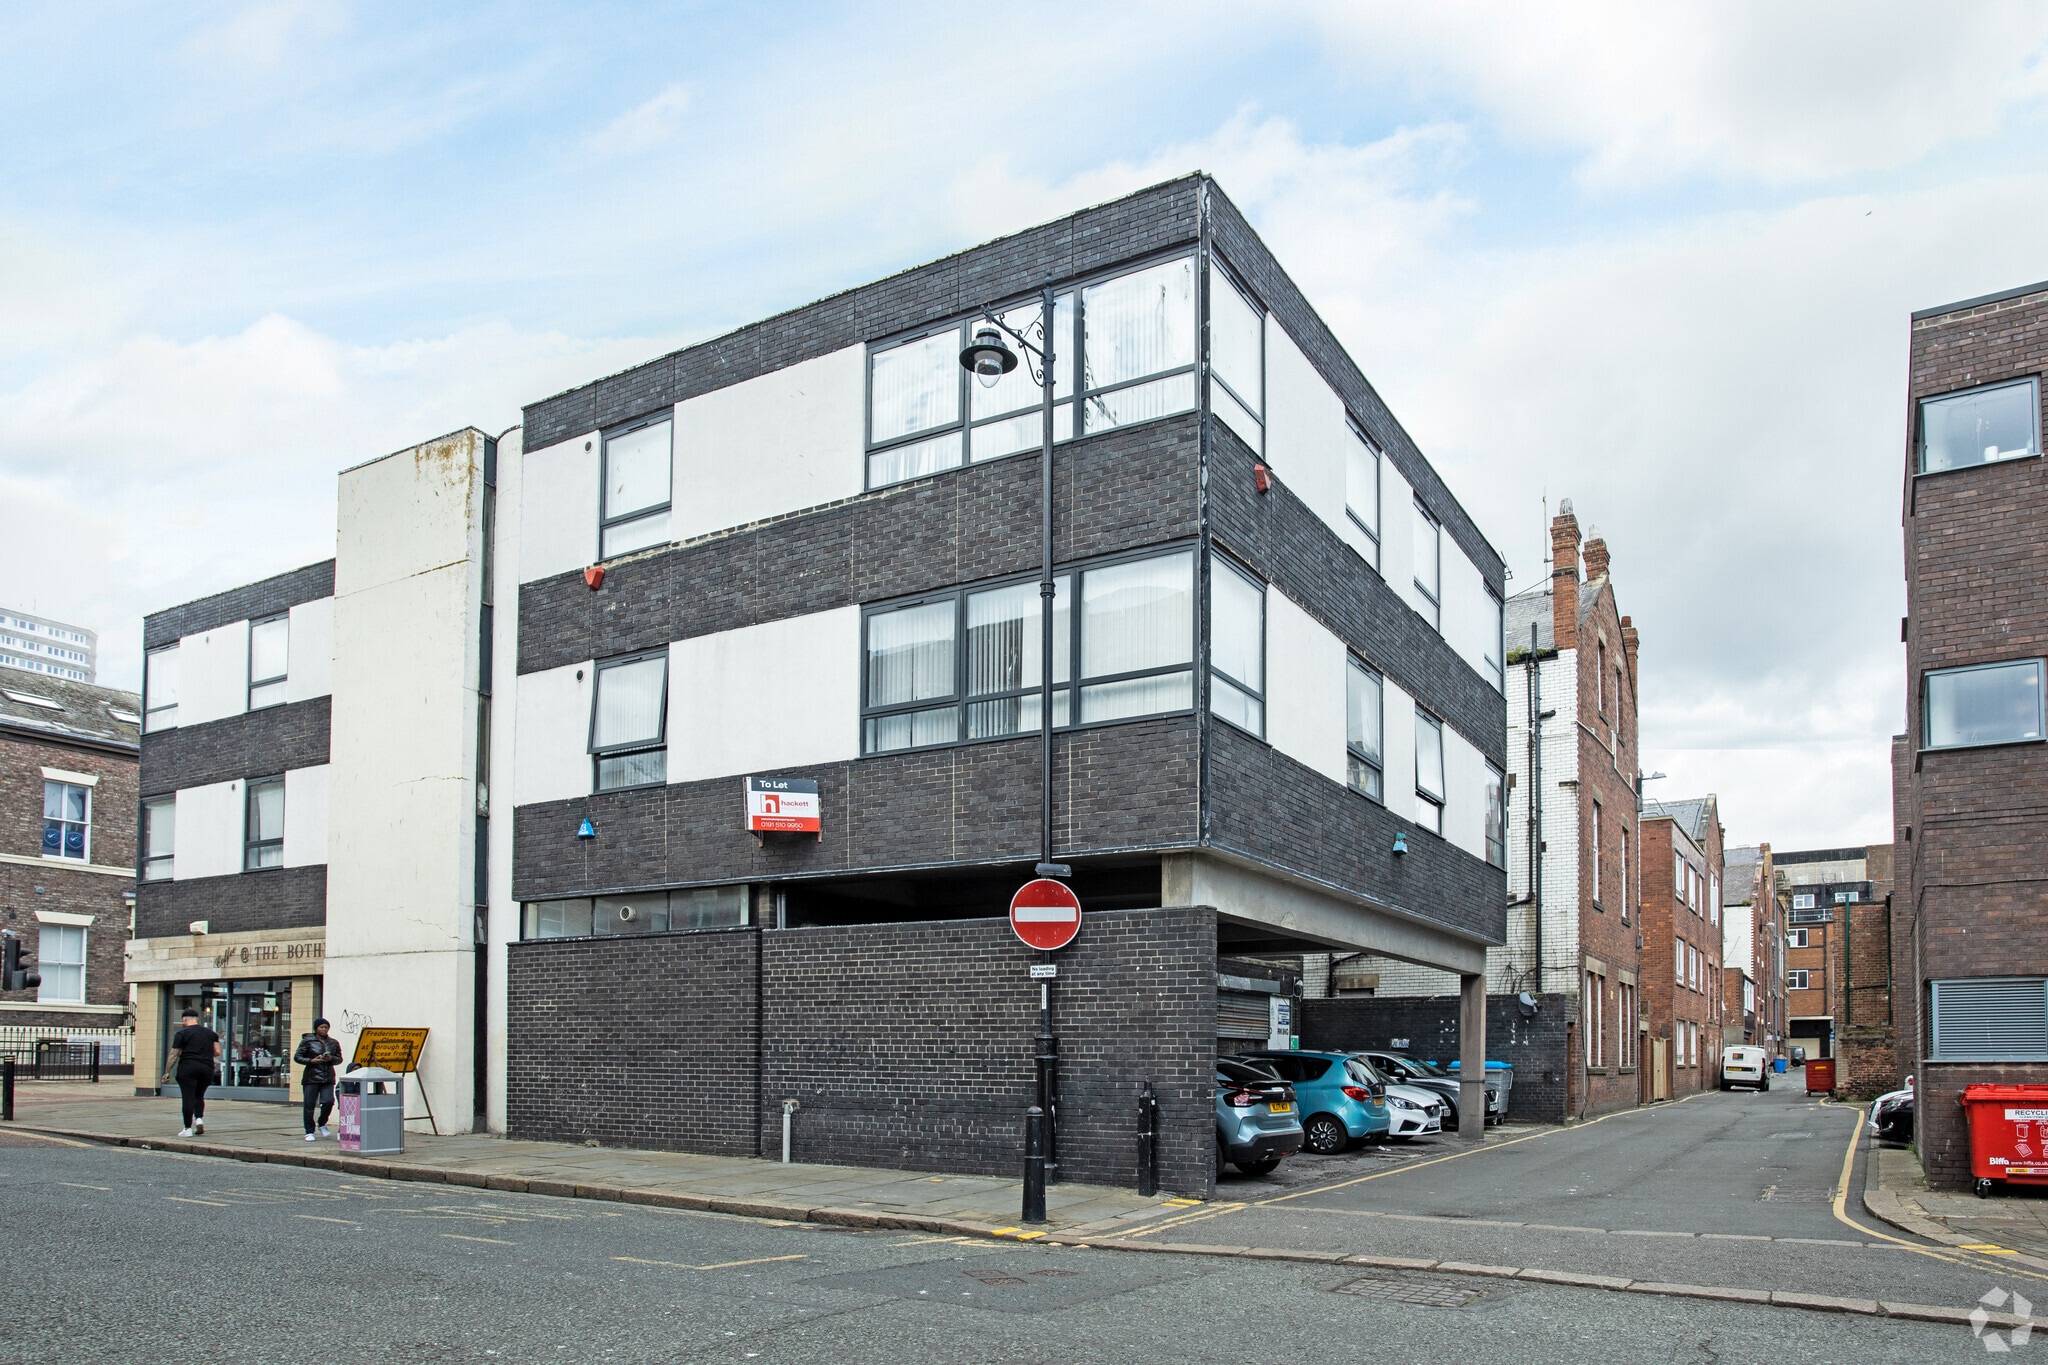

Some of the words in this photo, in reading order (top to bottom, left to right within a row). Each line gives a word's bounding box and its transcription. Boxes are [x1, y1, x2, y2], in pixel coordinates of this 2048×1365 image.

[759, 780, 772, 788] To
[773, 781, 788, 789] Let
[240, 947, 249, 964] @
[254, 945, 279, 961] THE
[1989, 1157, 2010, 1165] Biffa
